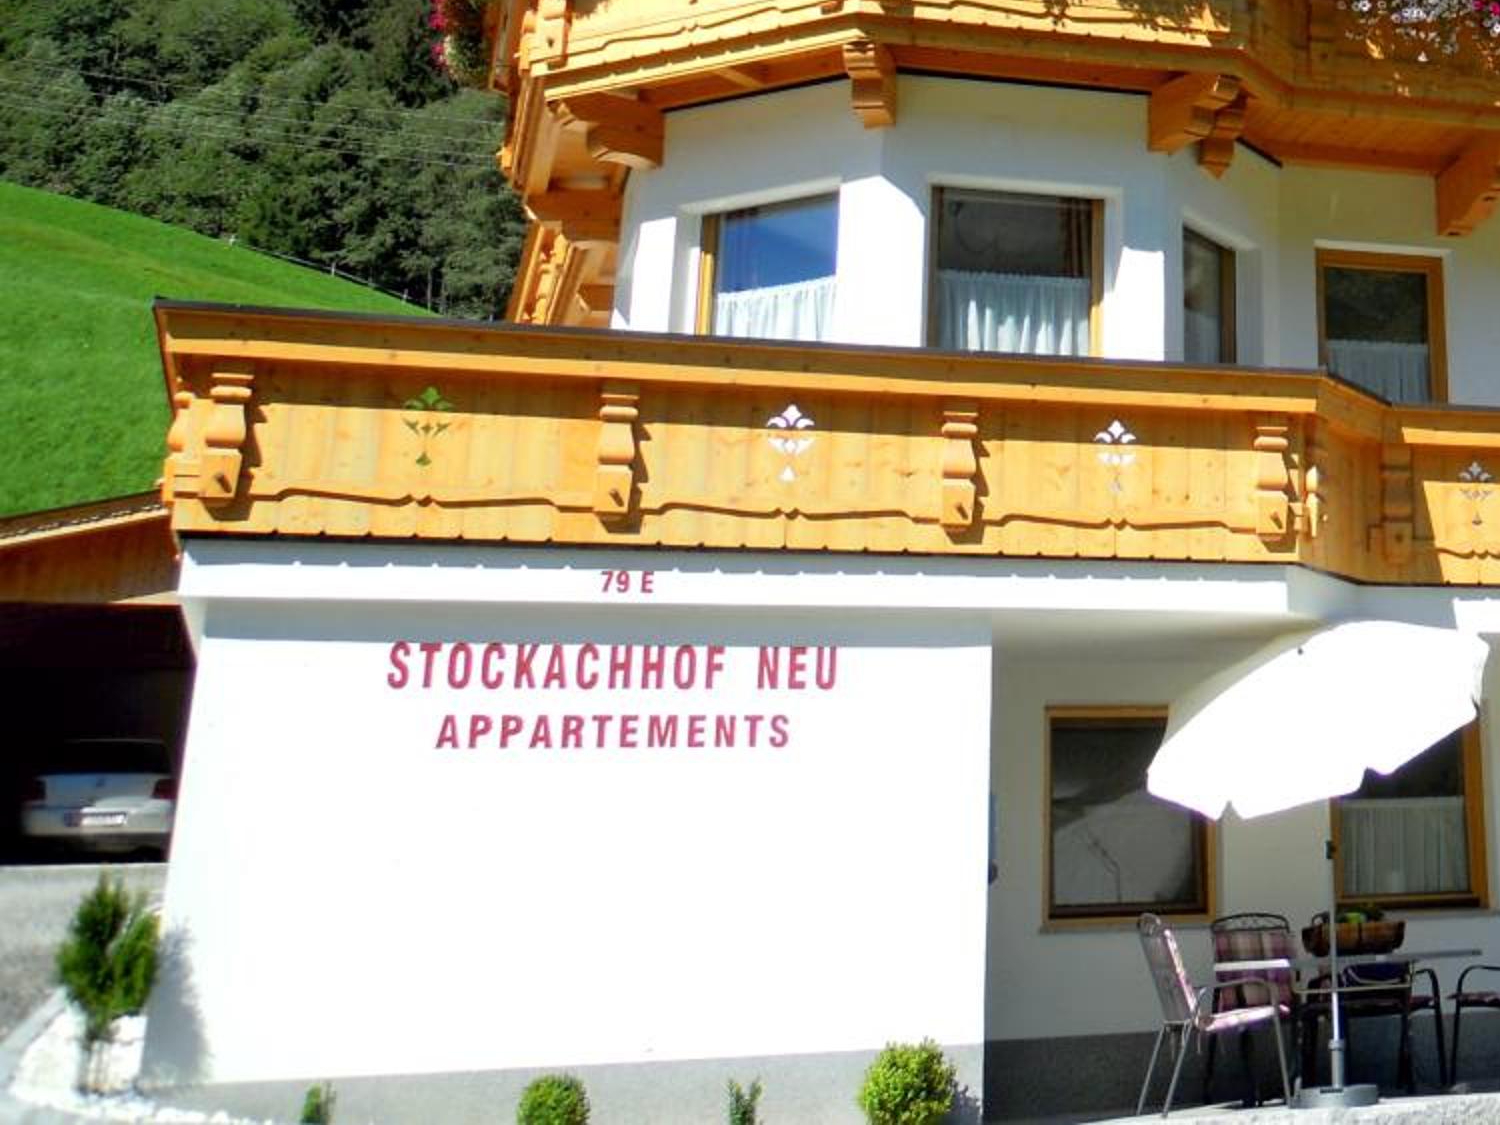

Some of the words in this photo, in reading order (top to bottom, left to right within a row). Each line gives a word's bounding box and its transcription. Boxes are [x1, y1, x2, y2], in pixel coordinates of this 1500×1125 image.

[600, 569, 630, 593] 79
[640, 570, 655, 594] E
[387, 641, 727, 690] STOCKACHHOF
[757, 643, 839, 690] NEU
[435, 713, 791, 749] APPARTEMENTS
